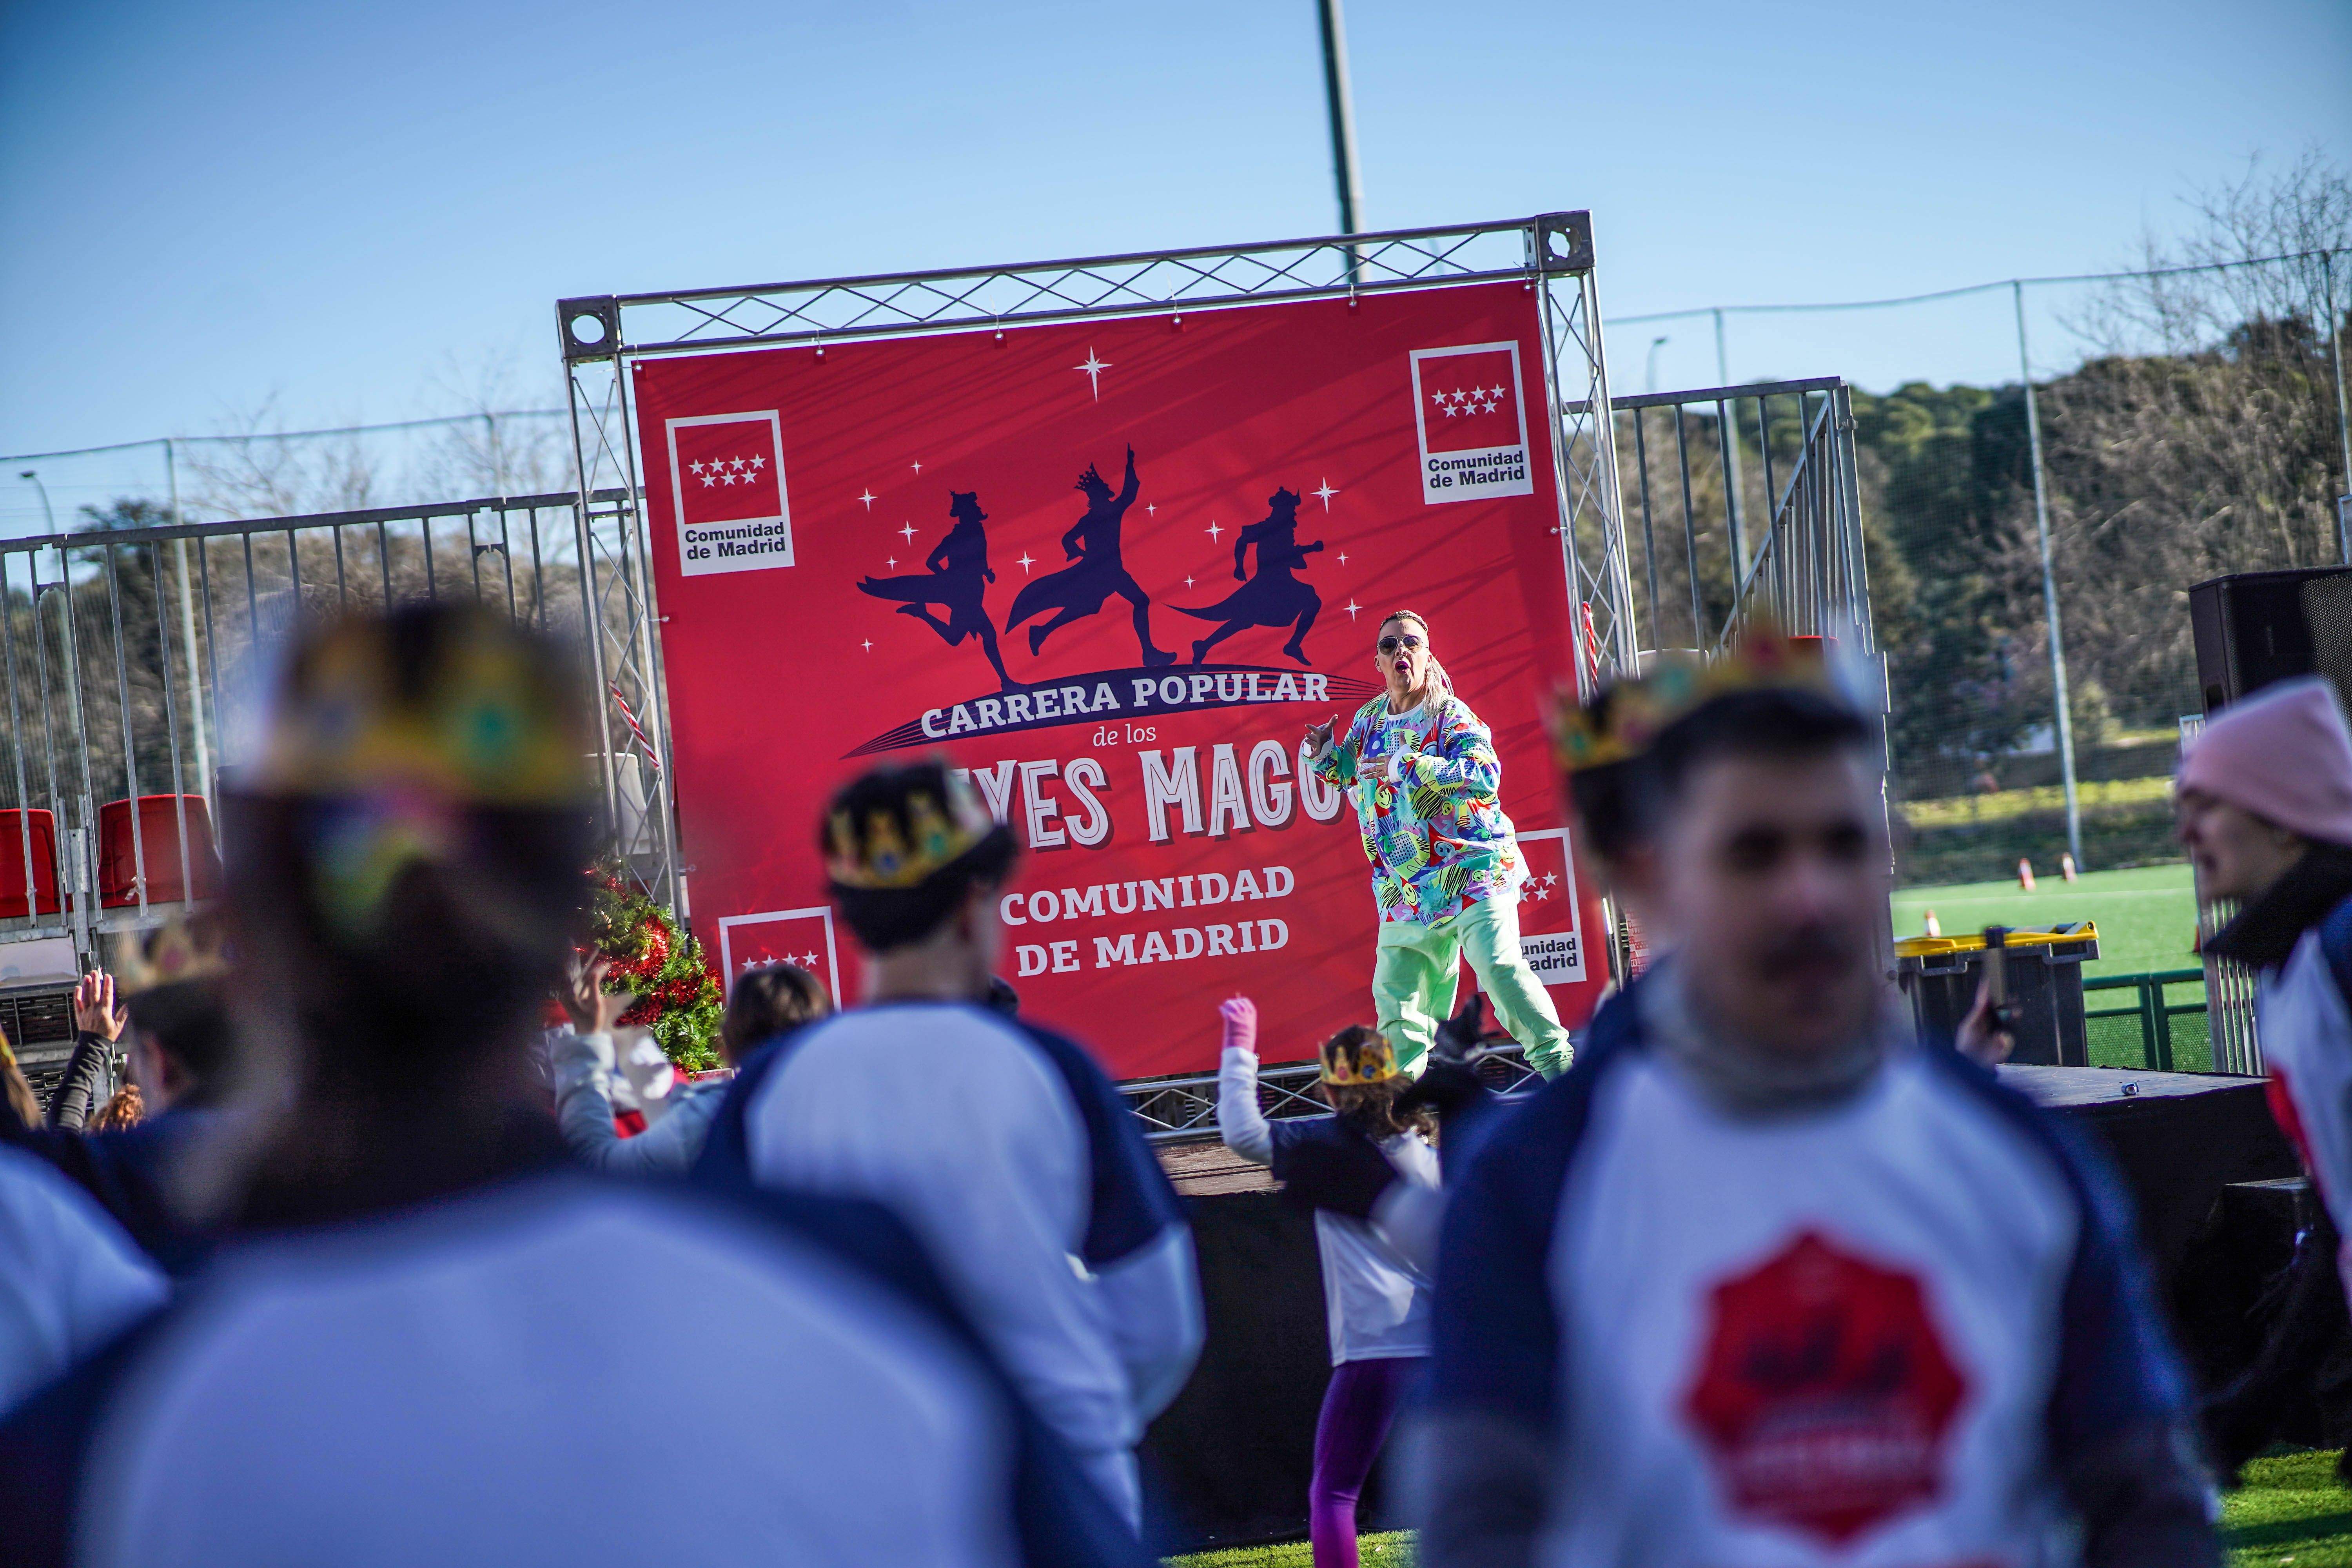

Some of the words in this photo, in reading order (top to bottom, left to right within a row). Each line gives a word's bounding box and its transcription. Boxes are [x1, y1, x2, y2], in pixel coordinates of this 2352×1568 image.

[1428, 450, 1524, 472] Comunidad
[1430, 474, 1453, 488] de
[1459, 466, 1525, 486] Madrid
[685, 522, 784, 543] Comunidad
[687, 545, 711, 560] de
[718, 537, 786, 557] Madrid
[921, 682, 1121, 739] CARRERA
[1132, 673, 1330, 708] POPULAR
[1093, 726, 1118, 748] de
[1125, 723, 1157, 745] los
[945, 757, 1109, 849] YES
[1138, 739, 1358, 842] MAGO
[1000, 866, 1294, 926] COMUNIDAD
[1015, 940, 1080, 977] DE
[1093, 918, 1289, 969] MADRID
[1521, 937, 1576, 956] unidad
[1530, 953, 1578, 971] adrid
